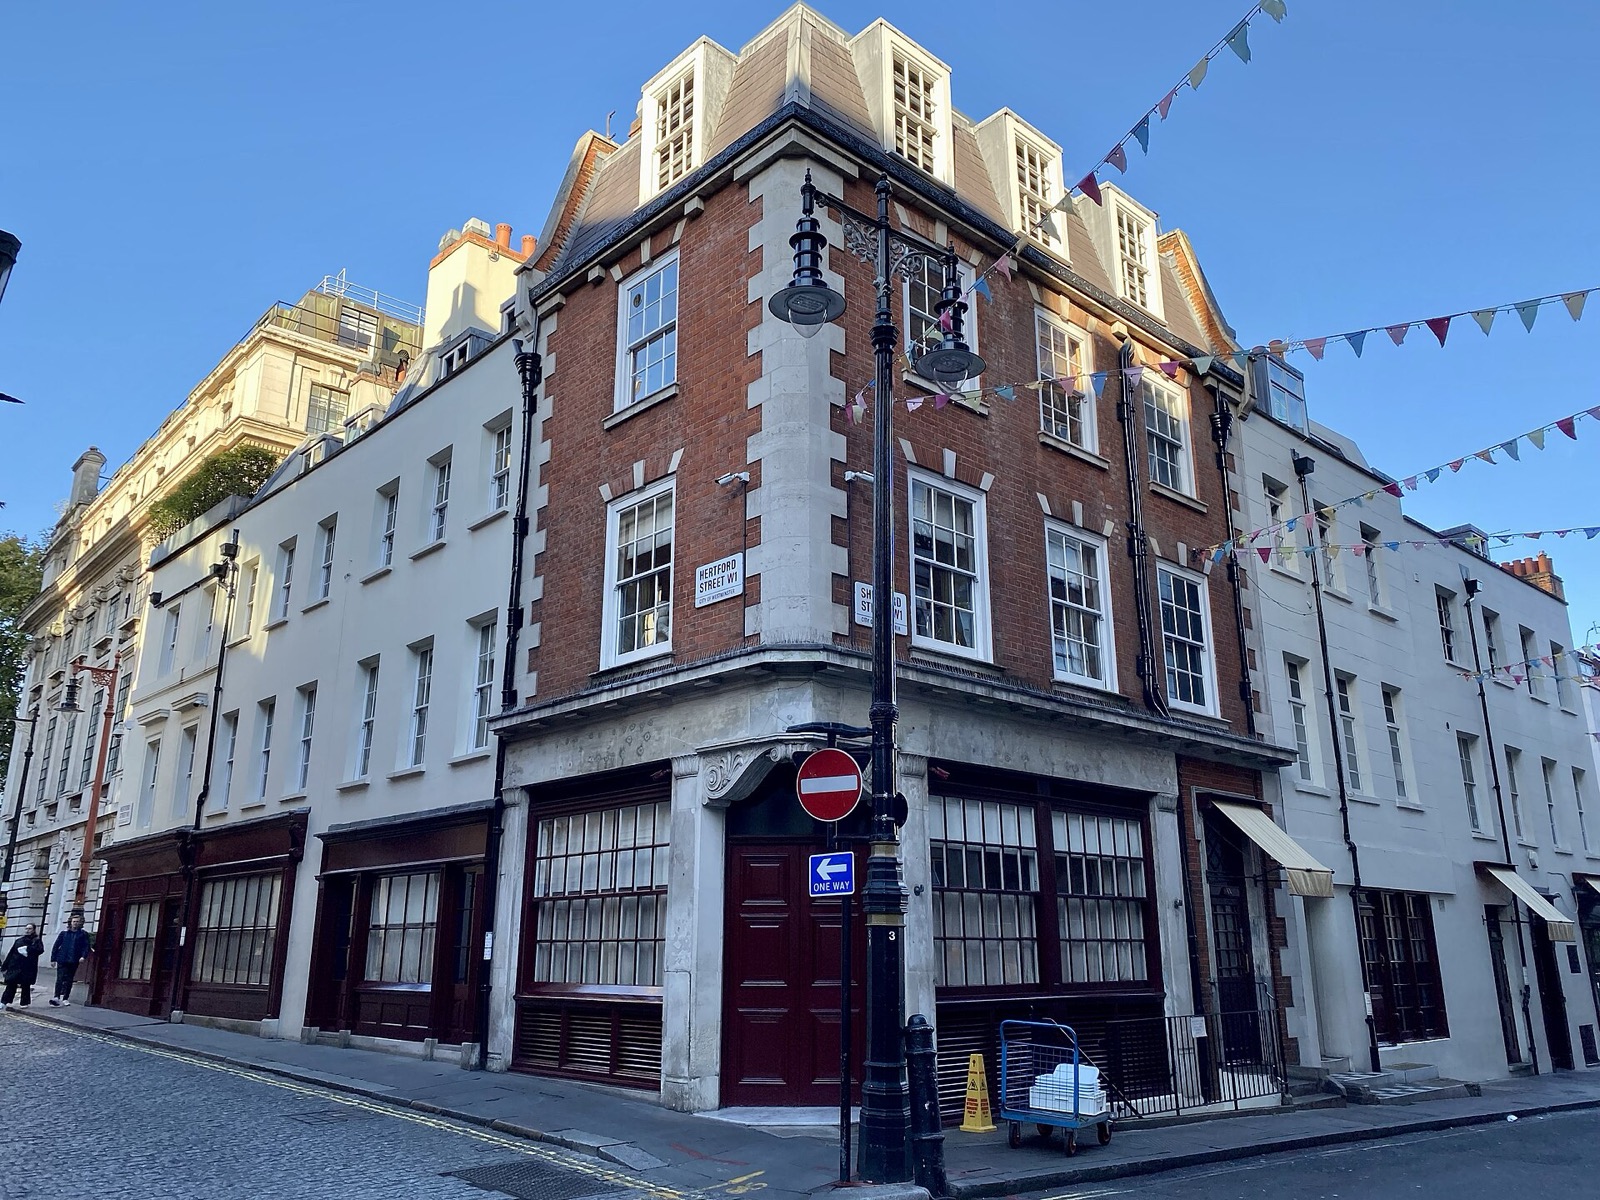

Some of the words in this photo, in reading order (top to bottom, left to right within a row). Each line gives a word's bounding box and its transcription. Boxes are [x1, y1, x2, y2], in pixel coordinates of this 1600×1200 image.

[699, 559, 736, 580] HERTFORD
[699, 576, 725, 593] STREET
[727, 571, 738, 584] W1
[711, 588, 735, 600] WESTMINSTER
[813, 882, 830, 892] ONE
[832, 880, 850, 890] WAY
[888, 930, 896, 941] 3
